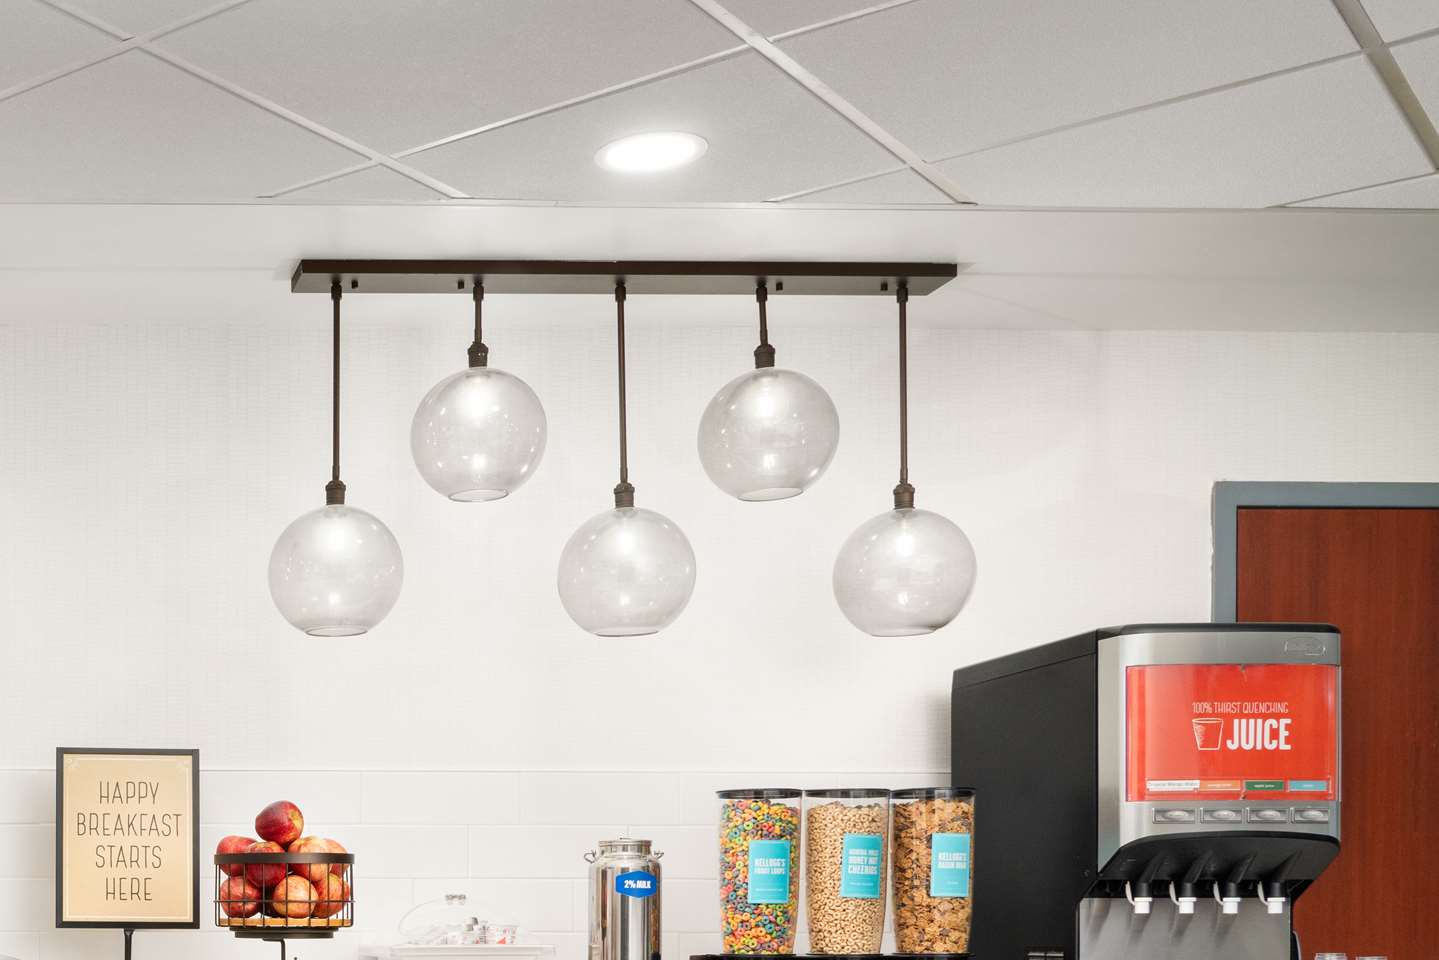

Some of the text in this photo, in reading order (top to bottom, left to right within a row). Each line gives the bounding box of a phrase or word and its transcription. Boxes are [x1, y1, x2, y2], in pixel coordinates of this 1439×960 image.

[1192, 702, 1289, 714] 100% THIRST QUENCHING
[1226, 718, 1292, 751] JUICE
[99, 781, 159, 804] HAPPY
[77, 812, 182, 837] BREAKFAST
[95, 845, 162, 869] STARTS
[848, 864, 878, 875] CHEERIOS
[105, 877, 152, 901] HERE
[623, 880, 652, 889] 2% MILK
